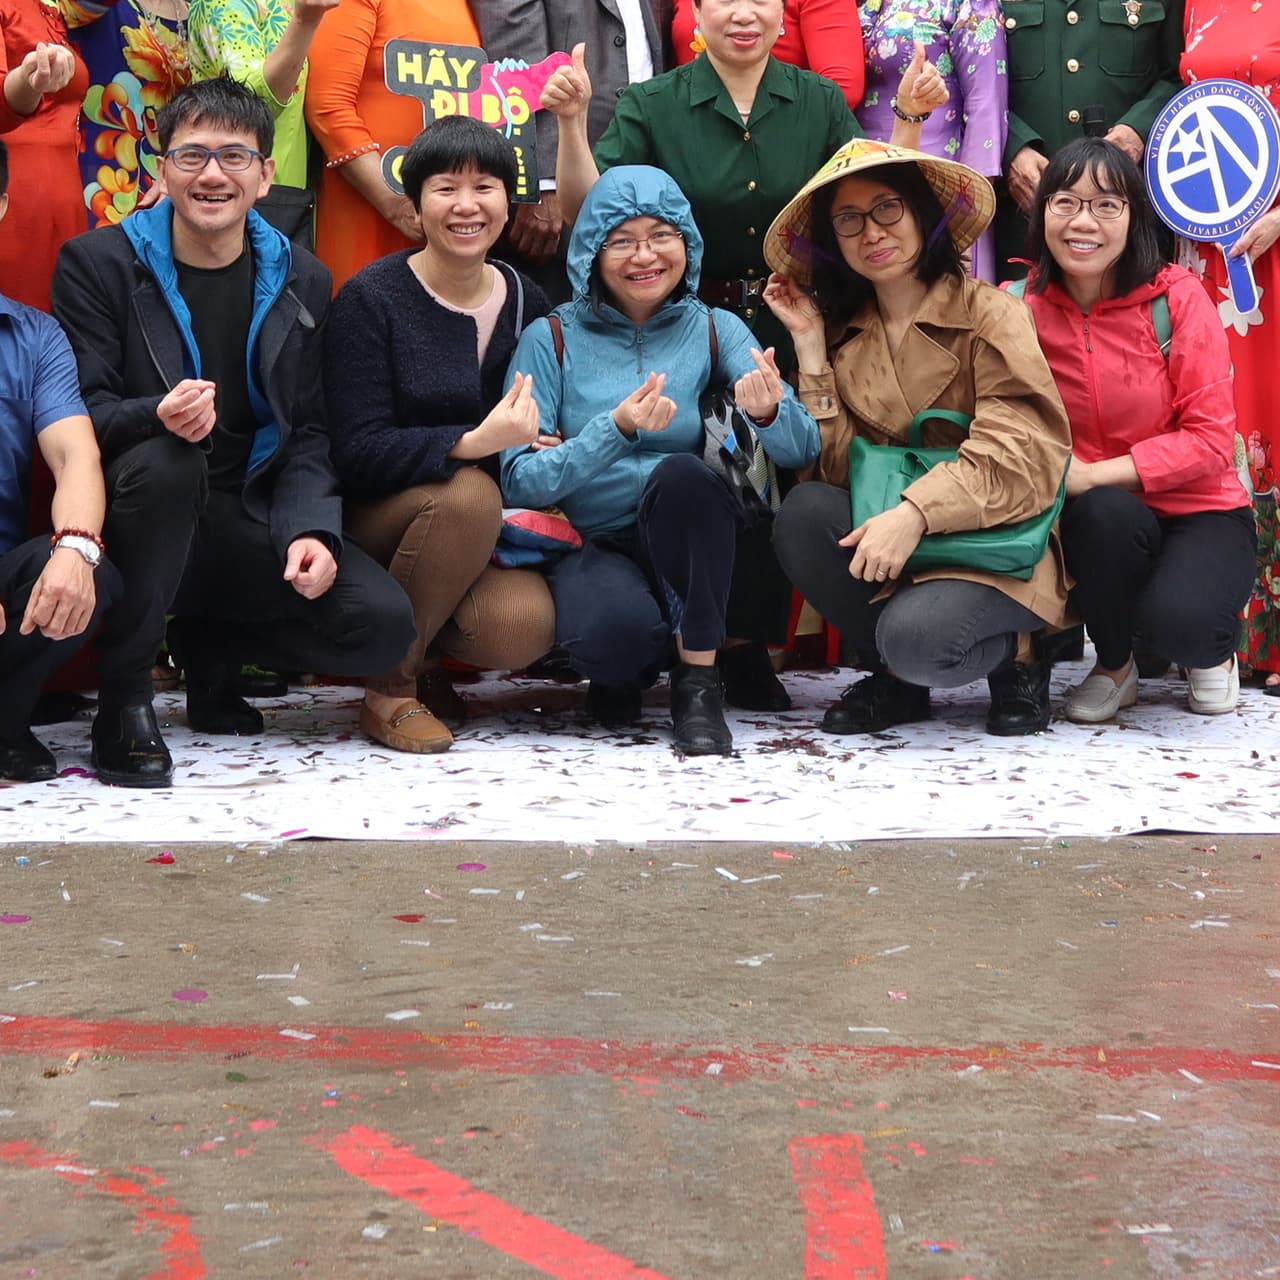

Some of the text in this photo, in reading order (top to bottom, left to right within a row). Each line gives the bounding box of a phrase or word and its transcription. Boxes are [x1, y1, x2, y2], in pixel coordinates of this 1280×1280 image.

[397, 49, 476, 88] HÃY
[431, 89, 469, 119] ĐI
[1234, 196, 1265, 227] HANOI
